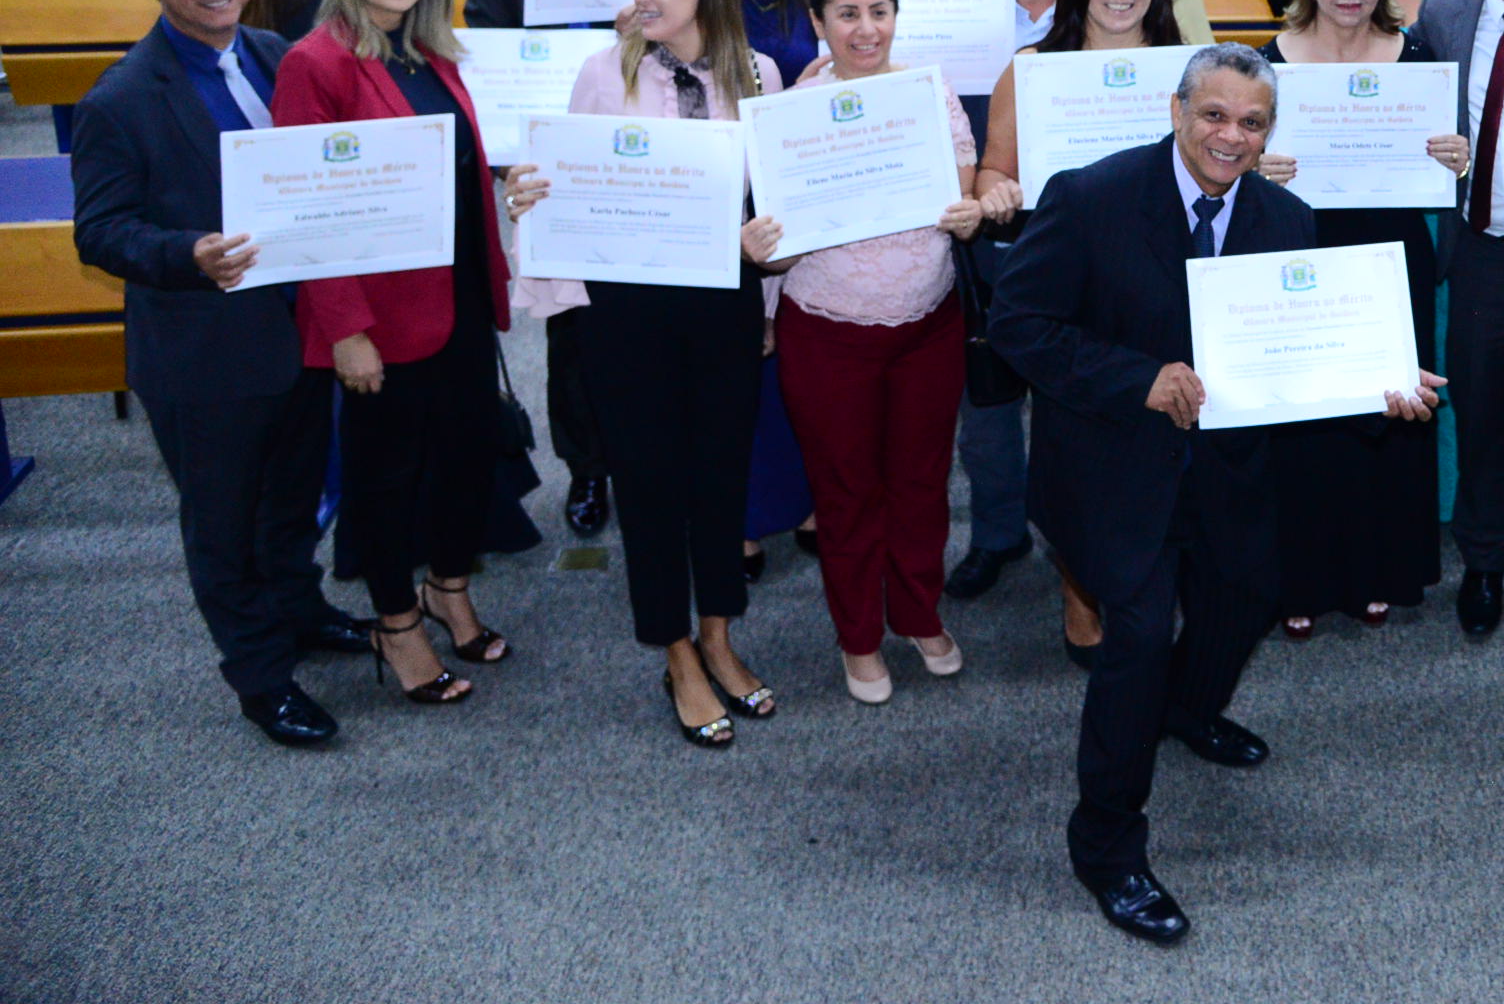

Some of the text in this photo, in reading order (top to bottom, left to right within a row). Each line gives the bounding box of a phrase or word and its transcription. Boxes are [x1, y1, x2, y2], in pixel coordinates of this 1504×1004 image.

[1228, 302, 1270, 315] Diploma
[1289, 298, 1320, 309] Honra
[1339, 293, 1373, 305] Mérito
[1326, 340, 1345, 348] Silva
